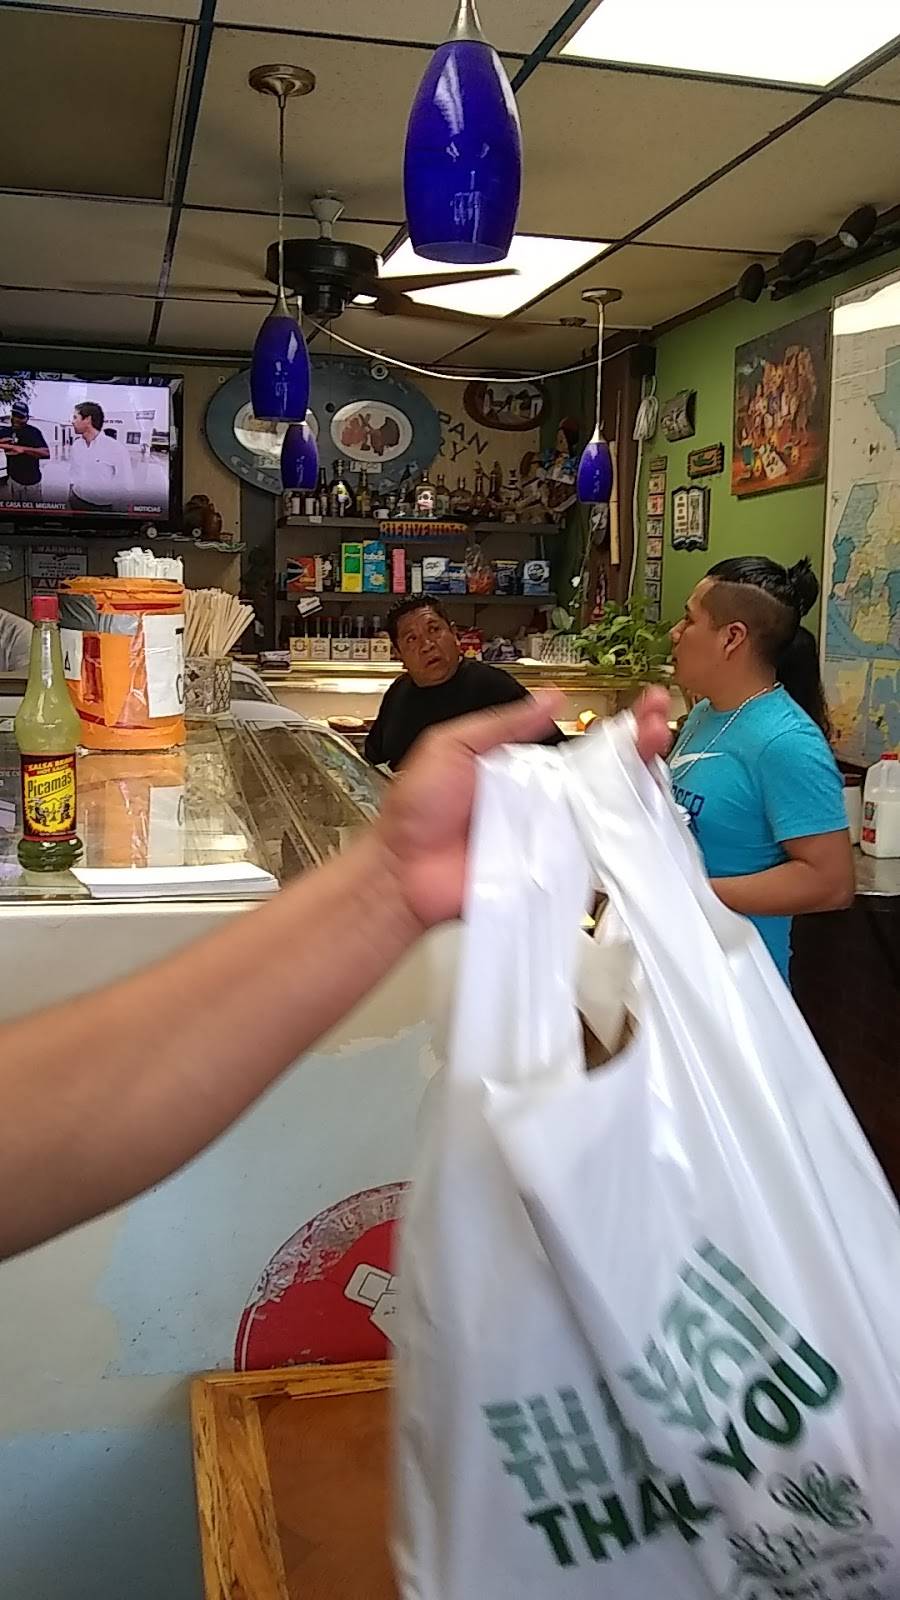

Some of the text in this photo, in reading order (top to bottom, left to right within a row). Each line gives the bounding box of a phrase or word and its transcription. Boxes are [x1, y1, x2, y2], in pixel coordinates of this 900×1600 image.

[35, 502, 66, 510] MIGRANTE
[27, 772, 72, 799] Picamas
[697, 1336, 841, 1485] YOU
